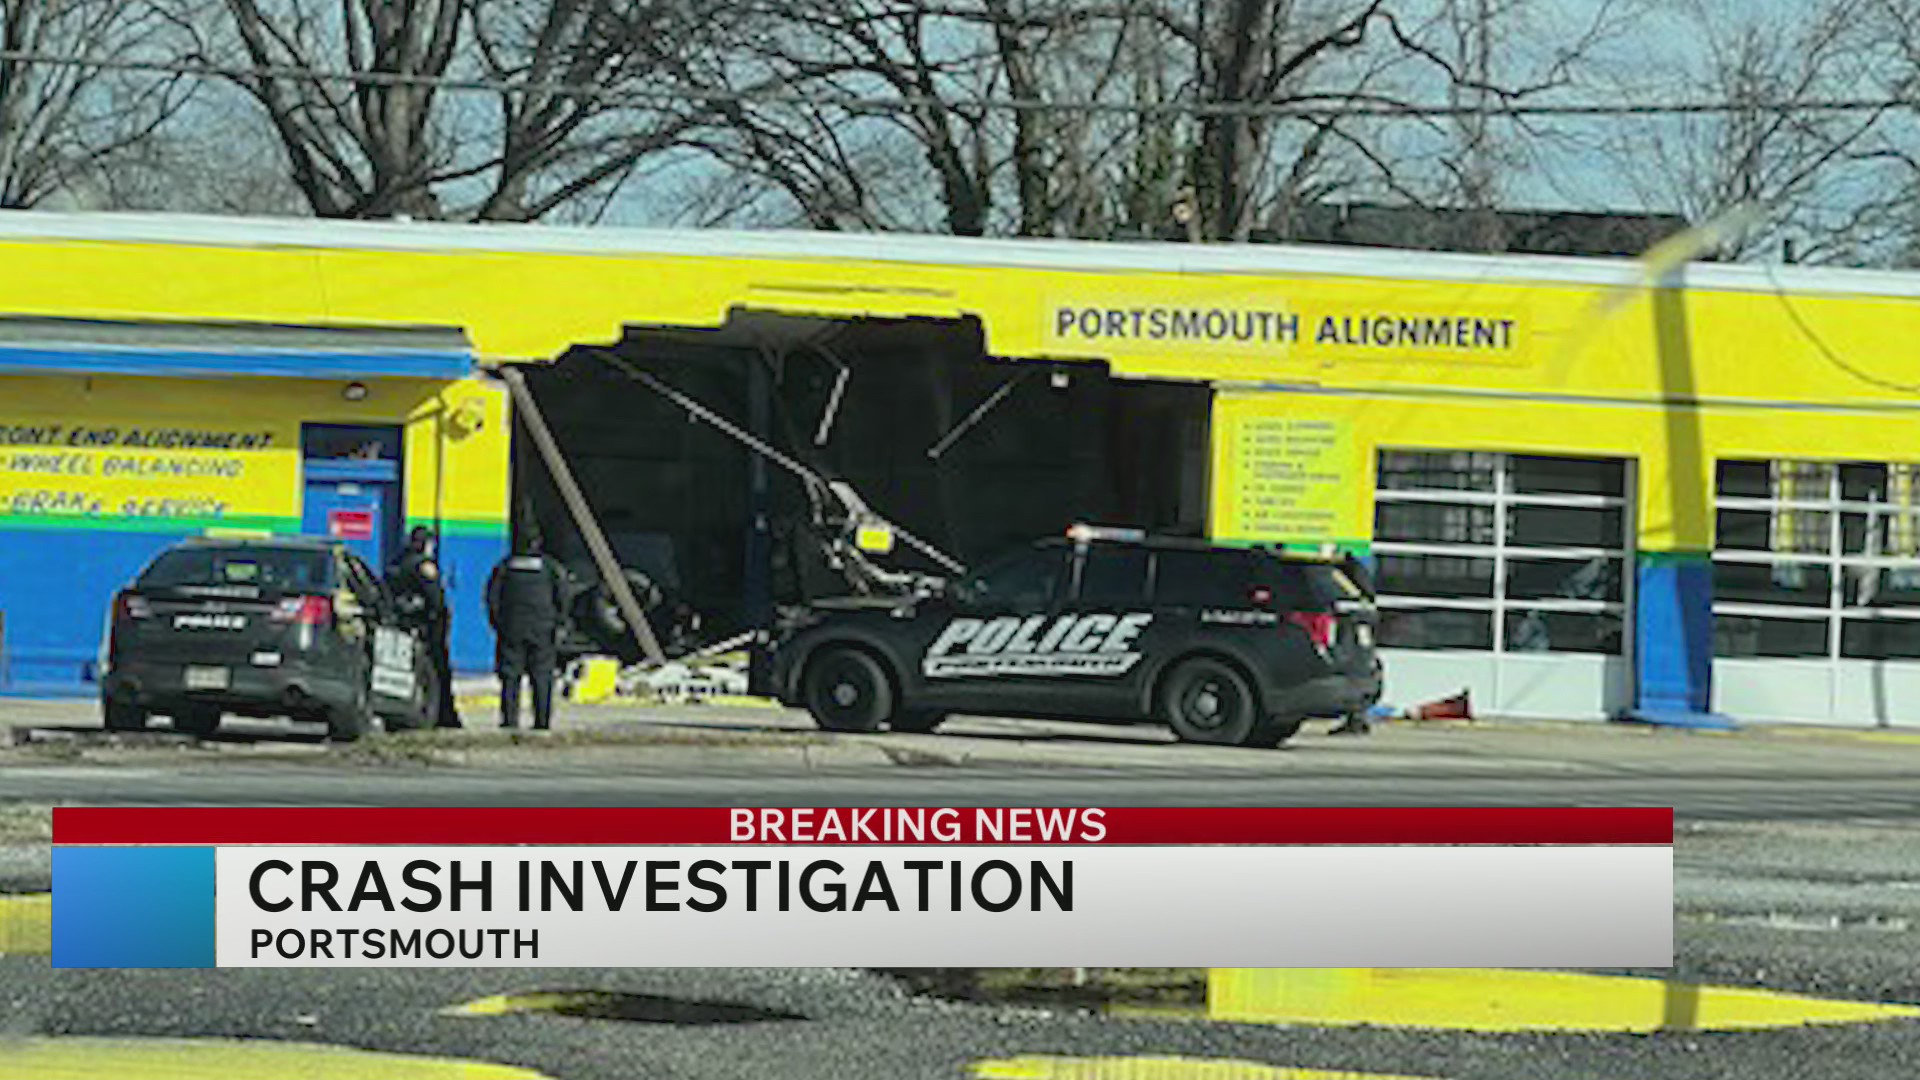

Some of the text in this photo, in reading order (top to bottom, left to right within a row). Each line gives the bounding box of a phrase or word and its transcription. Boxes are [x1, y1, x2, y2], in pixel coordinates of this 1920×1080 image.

[1055, 307, 1516, 350] PORTSMOUTH ALIGNMENT
[68, 426, 118, 447] END
[123, 429, 274, 450] ALIGNMENT
[11, 453, 244, 478] WHEEL BALANCING
[926, 611, 1154, 655] POLICE
